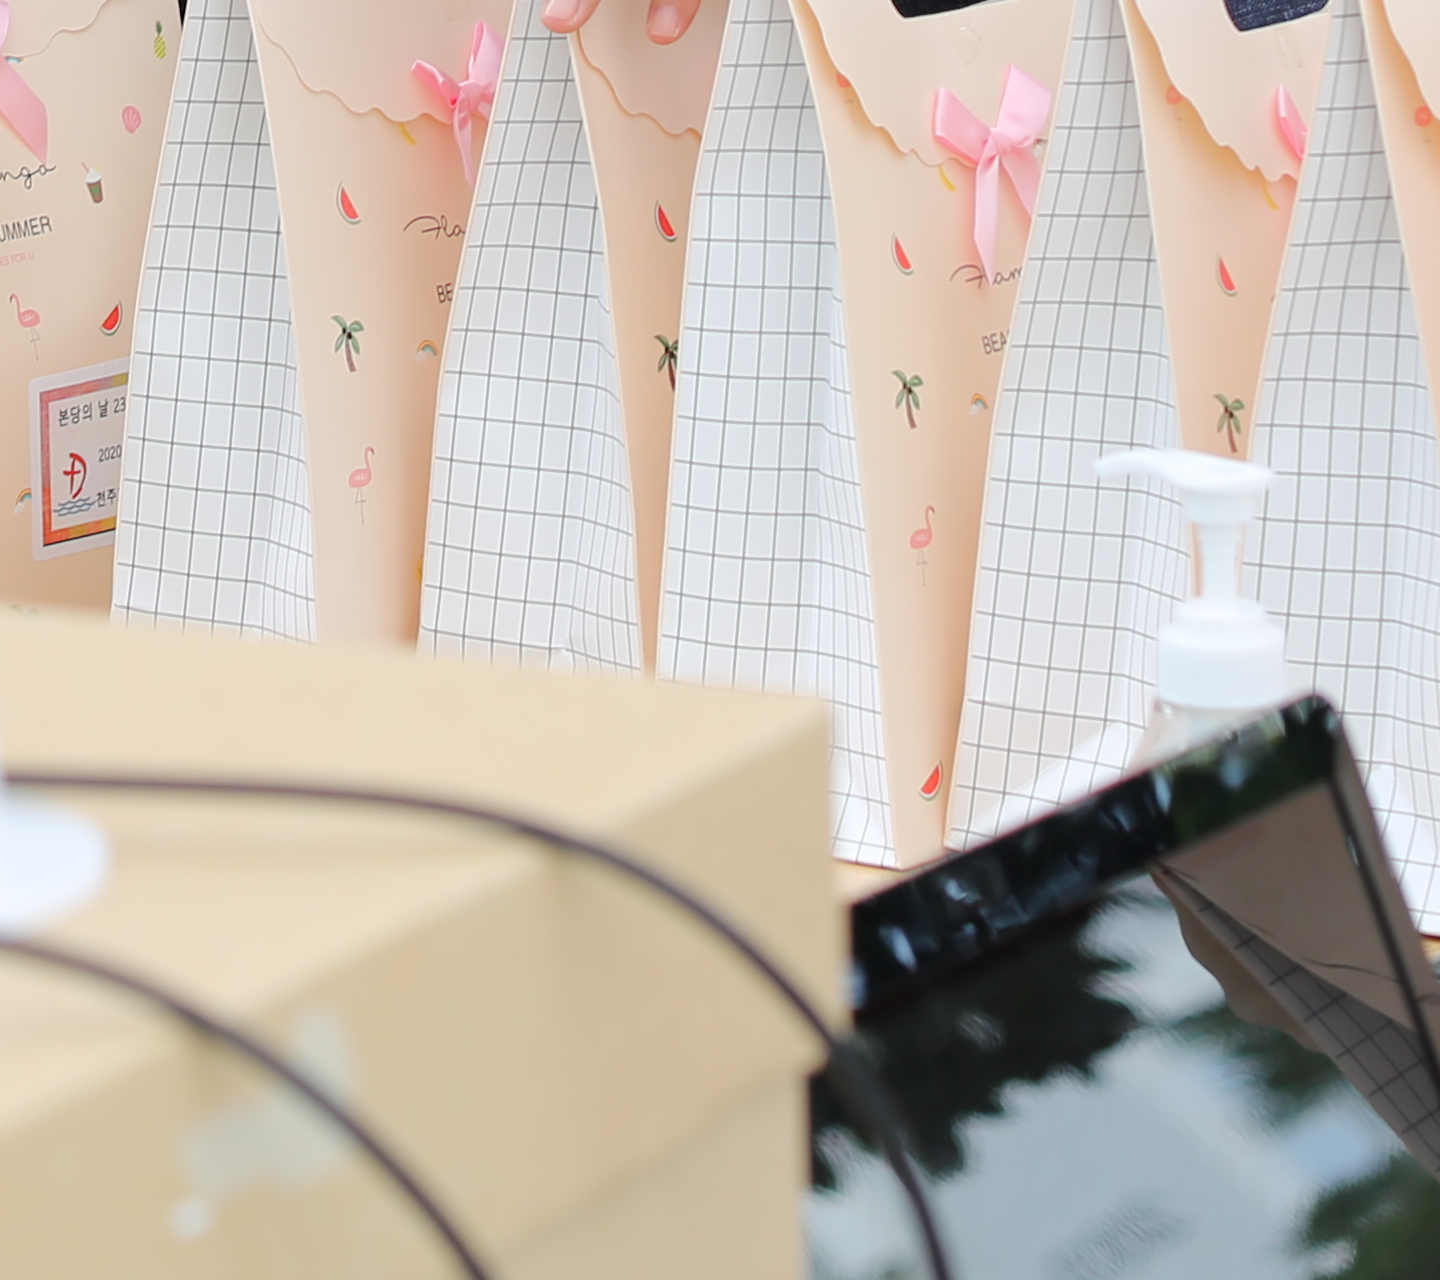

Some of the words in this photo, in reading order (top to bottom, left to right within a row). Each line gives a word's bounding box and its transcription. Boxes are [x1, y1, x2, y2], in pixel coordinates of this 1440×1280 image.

[981, 329, 1010, 355] BEA
[58, 402, 93, 427] 본당의
[98, 399, 108, 419] 날
[96, 487, 120, 507] 천주
